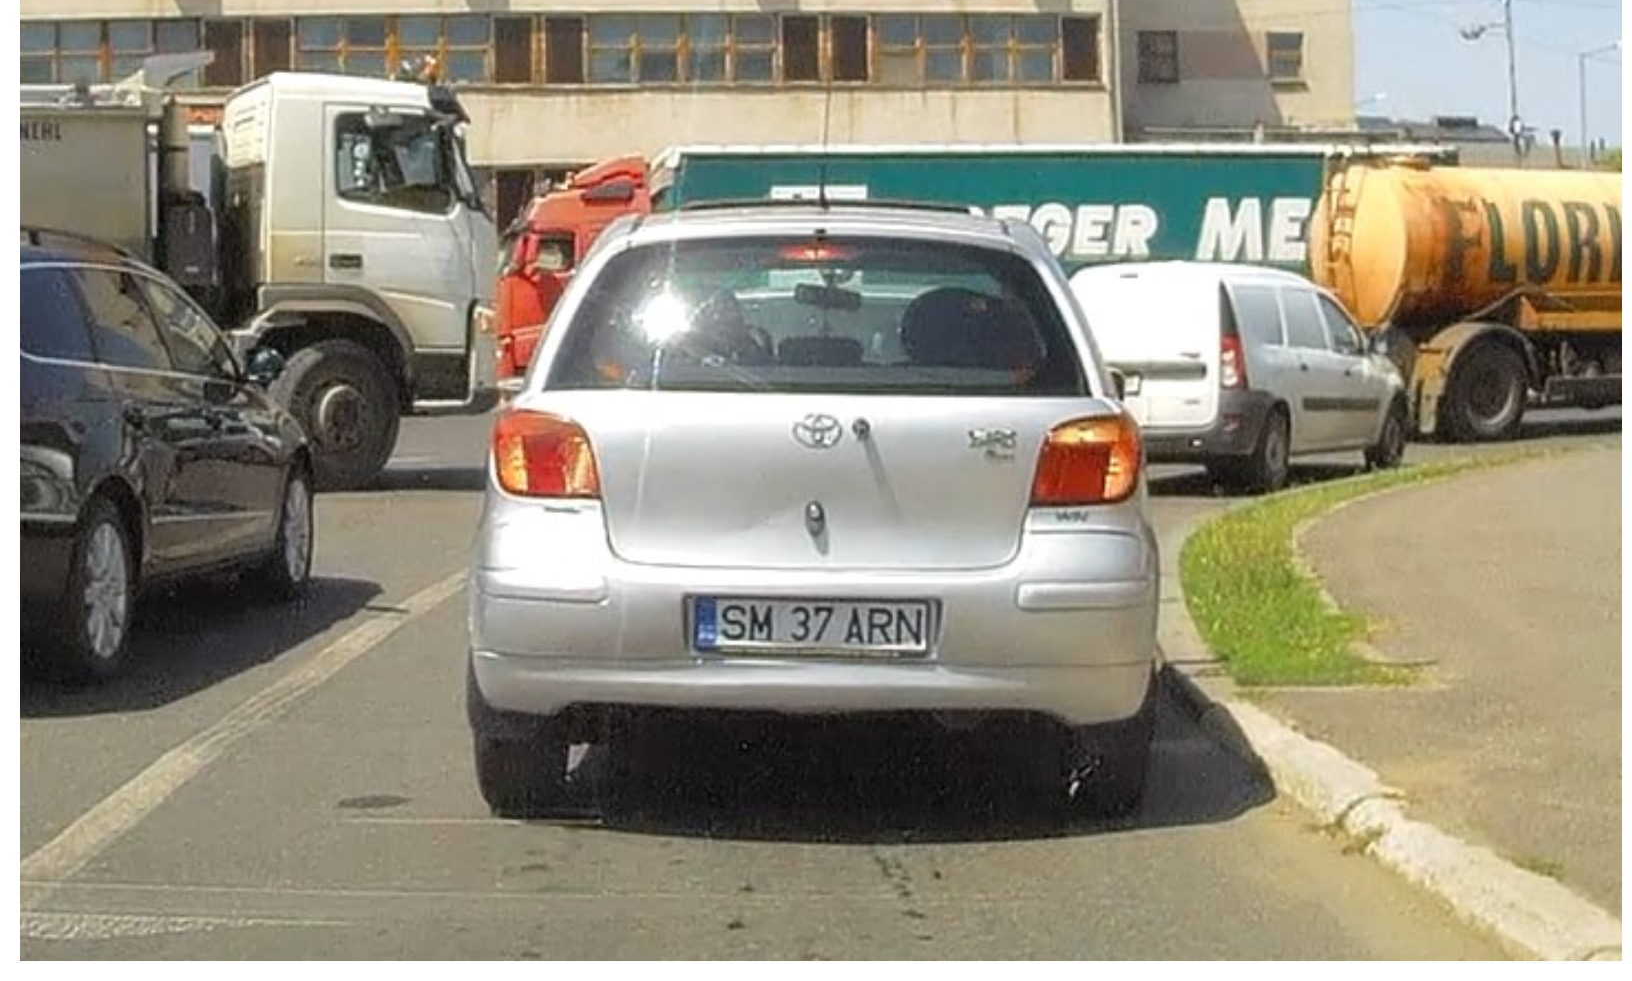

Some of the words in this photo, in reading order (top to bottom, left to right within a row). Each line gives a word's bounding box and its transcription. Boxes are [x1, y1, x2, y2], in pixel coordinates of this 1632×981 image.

[721, 604, 773, 642] SM
[789, 606, 834, 643] 37
[843, 607, 923, 645] ARN
